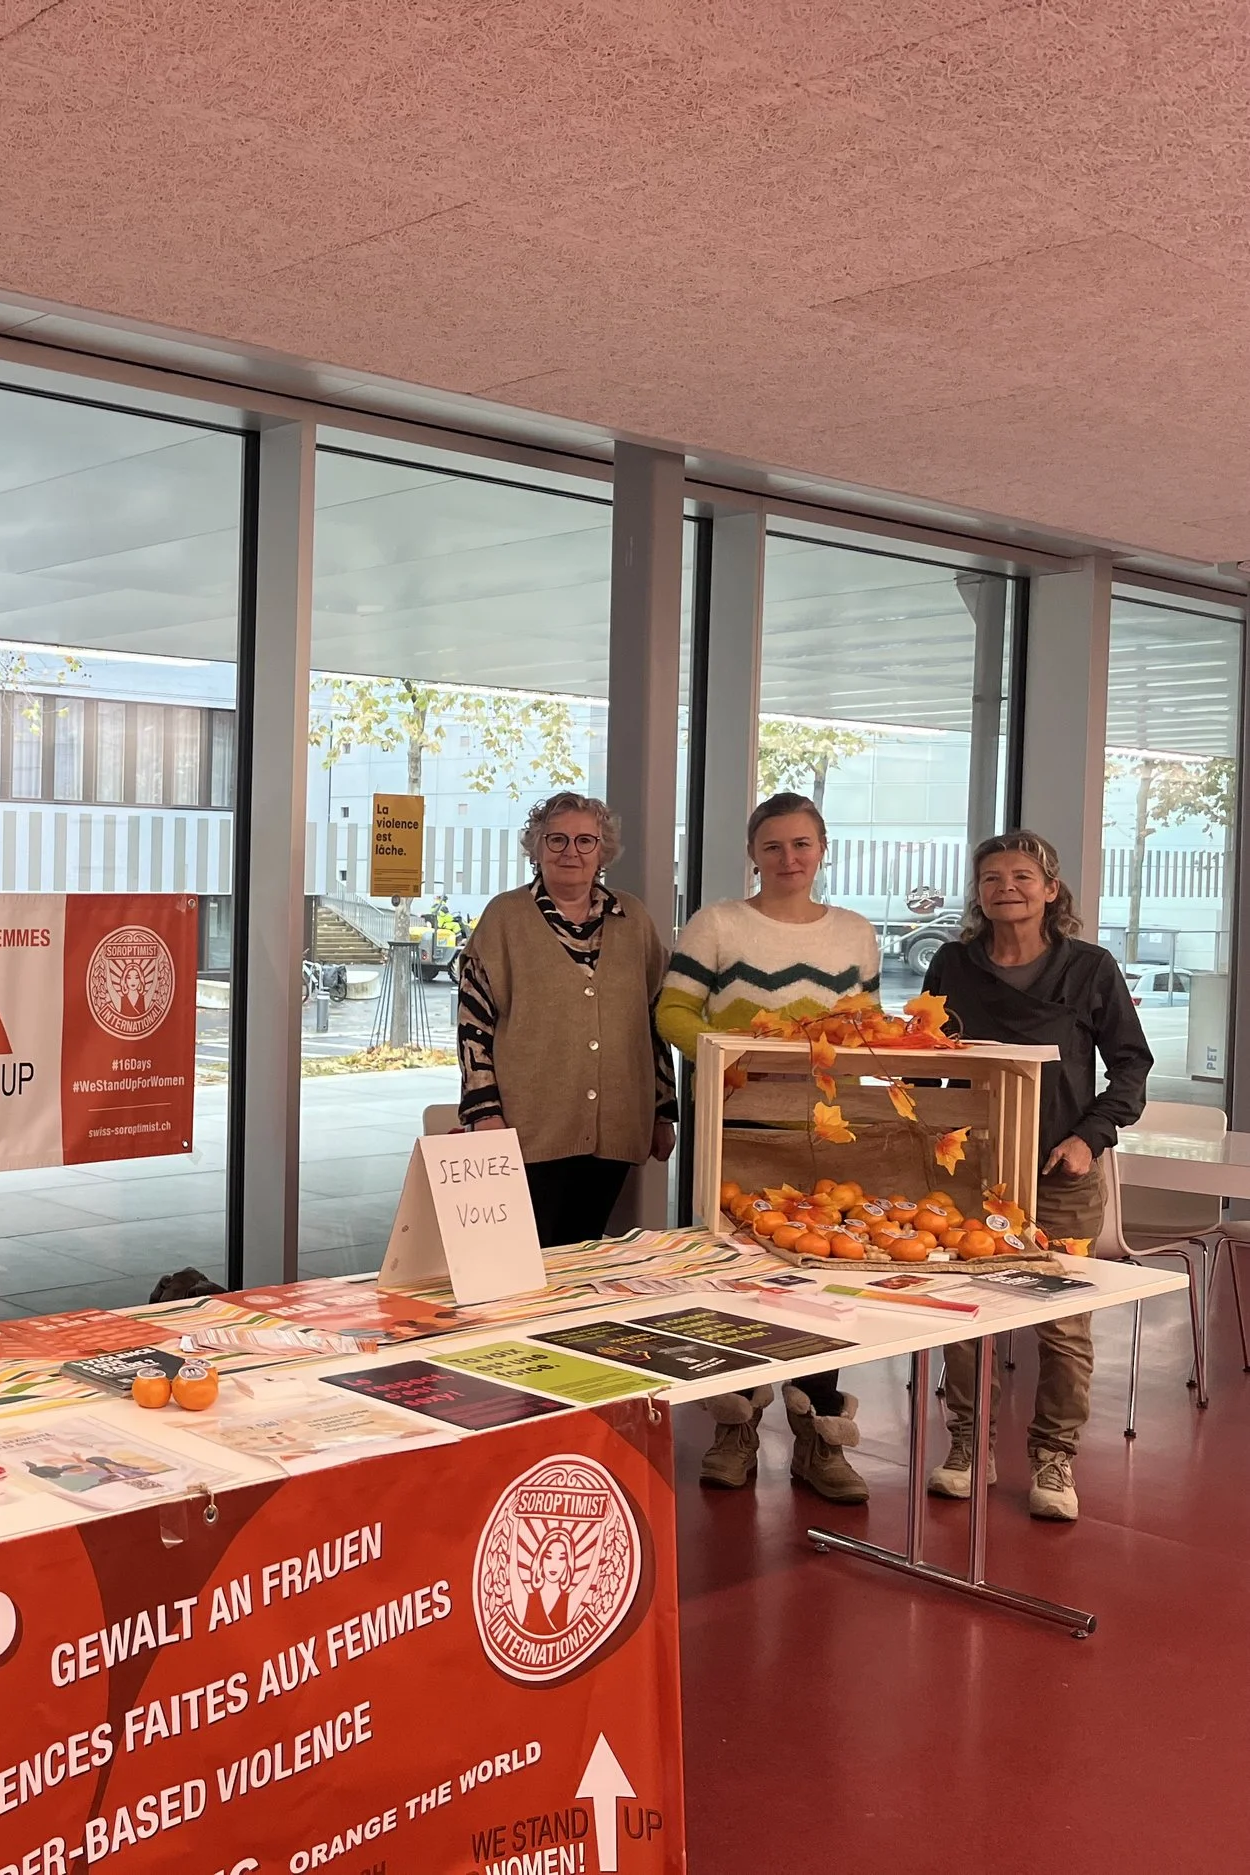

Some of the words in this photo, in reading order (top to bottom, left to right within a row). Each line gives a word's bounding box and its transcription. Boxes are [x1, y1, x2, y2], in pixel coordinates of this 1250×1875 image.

[376, 804, 389, 815] La
[376, 818, 419, 830] violence
[376, 832, 392, 842] est
[375, 844, 407, 856] lâche.
[106, 943, 157, 957] SOROPTIMIST
[102, 1005, 162, 1033] INTERNATIONAL
[112, 1058, 152, 1072] #16Days
[1206, 1046, 1218, 1070] PET
[2, 1062, 34, 1096] UP
[72, 1074, 185, 1094] #WeStandUpForWomen
[88, 1120, 171, 1138] swiss-soroptimist.ch
[440, 1156, 519, 1184] SERVEZ-
[456, 1203, 508, 1228] VOUS
[448, 1357, 481, 1365] Ta
[478, 1348, 524, 1361] voix
[476, 1361, 512, 1372] est
[510, 1353, 549, 1365] une
[494, 1364, 562, 1378] force.
[519, 1492, 607, 1516] SOROPTIMIST
[51, 1596, 199, 1687] GEWALT
[208, 1574, 253, 1632] AN
[262, 1522, 383, 1606] FRAUEN
[491, 1615, 596, 1665] INTERNATIONAL
[124, 1672, 249, 1753] FAITES
[258, 1635, 321, 1703] AUX
[325, 1580, 453, 1668] FEMMES
[216, 1701, 373, 1803] VIOLENCE
[289, 1807, 397, 1875] ORANGE
[405, 1779, 452, 1820] THE
[459, 1741, 543, 1796] WORLD
[472, 1825, 507, 1864] WE
[511, 1807, 589, 1852] STAND
[623, 1805, 664, 1842] UP
